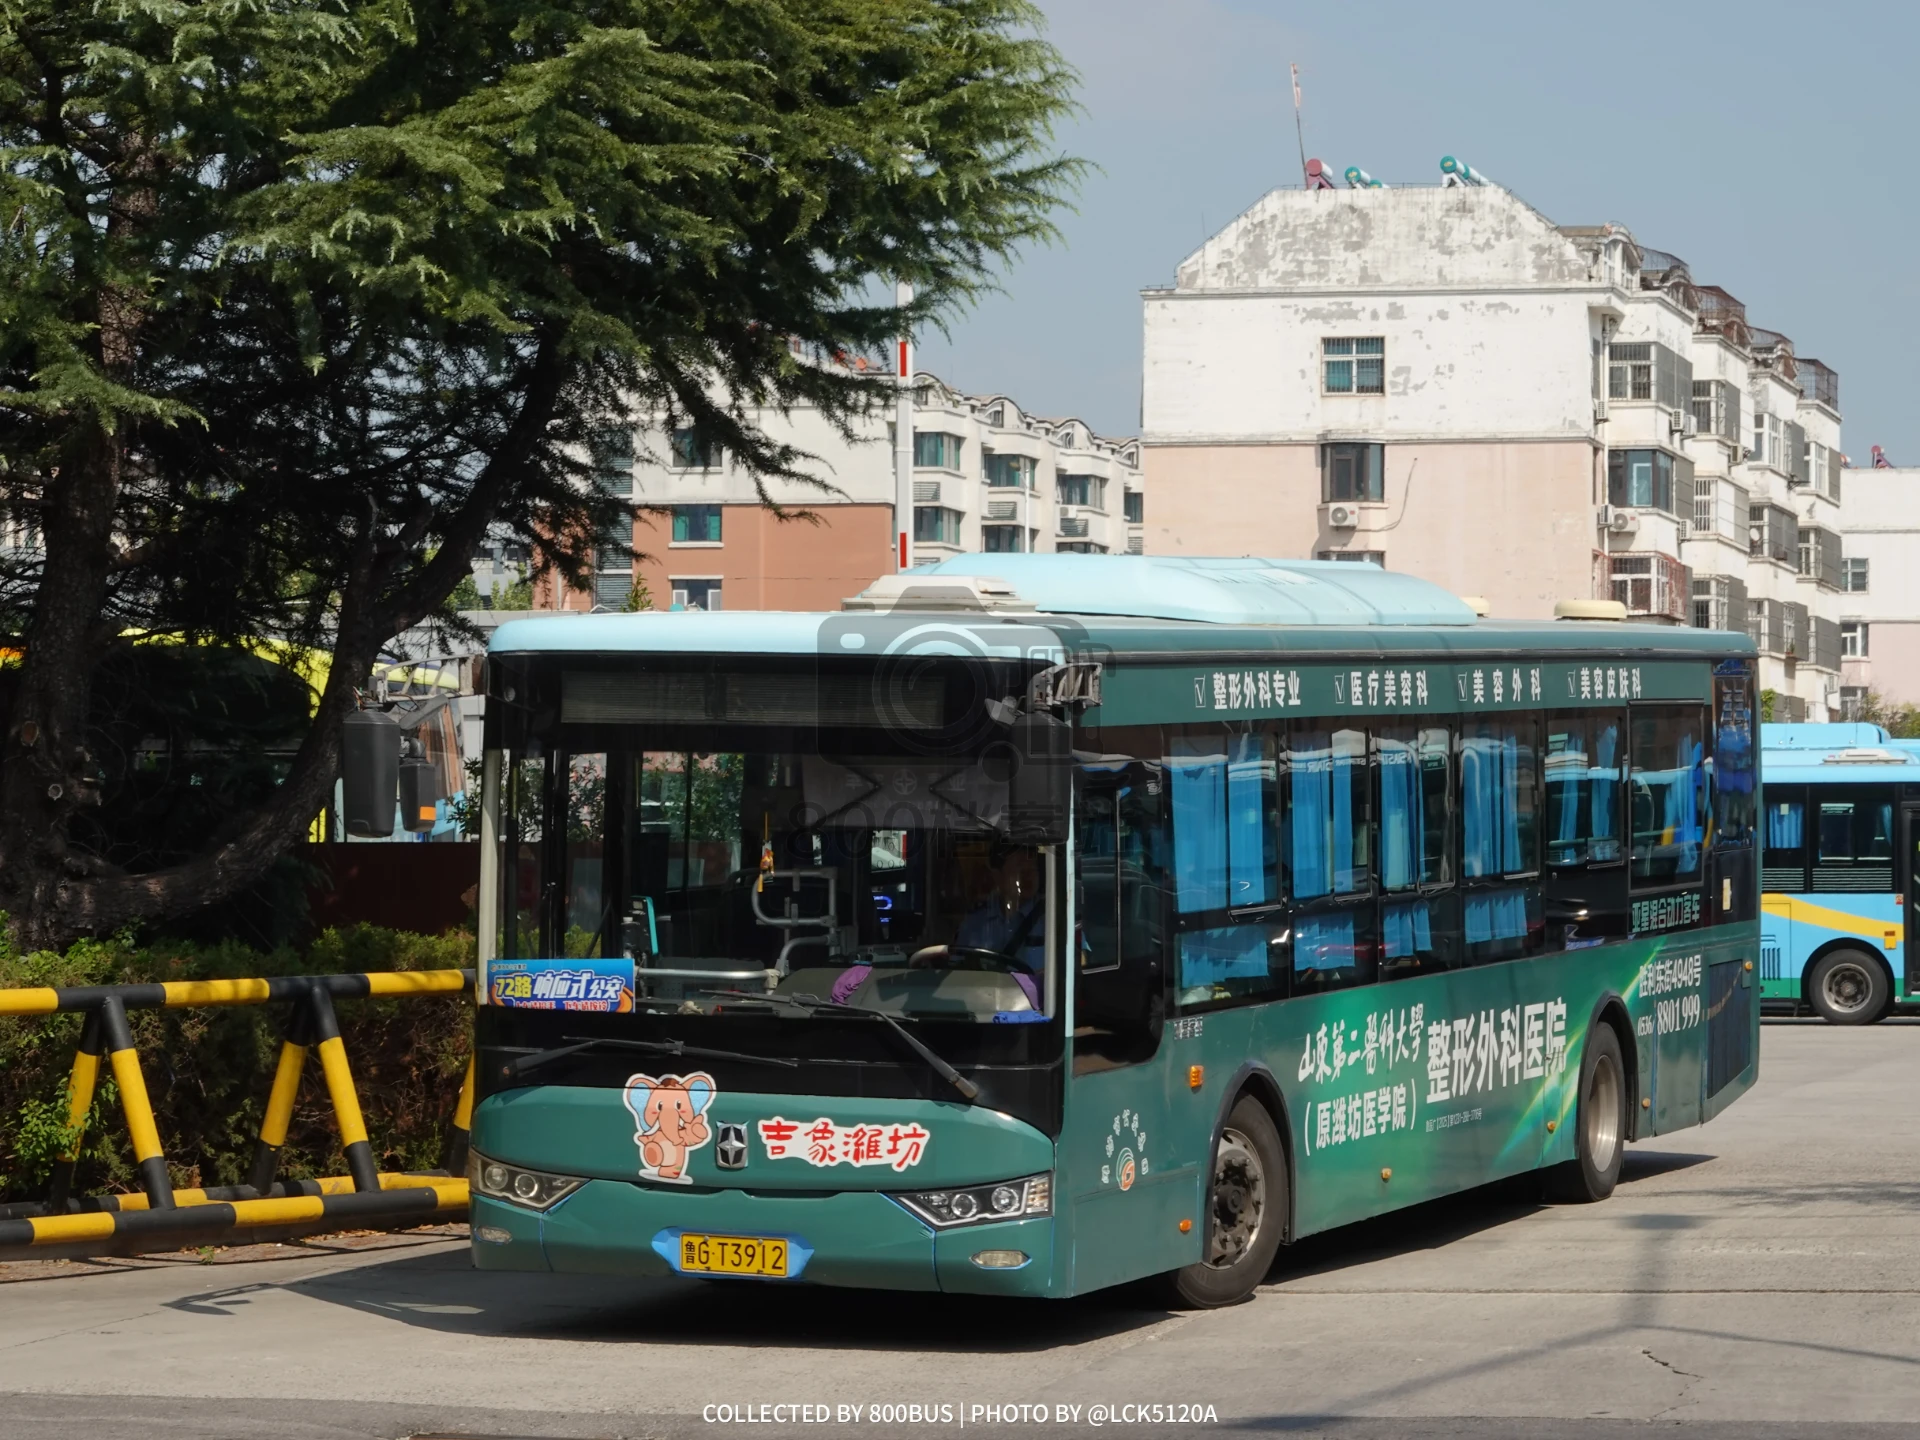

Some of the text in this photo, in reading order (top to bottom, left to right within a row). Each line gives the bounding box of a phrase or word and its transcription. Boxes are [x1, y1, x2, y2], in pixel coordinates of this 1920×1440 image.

[1212, 670, 1301, 710] 整形外科专业
[1350, 670, 1429, 706] 医疗美容科
[1472, 668, 1541, 704] 美容外科
[1580, 667, 1642, 700] 美容皮肤科
[1631, 893, 1701, 933] 亚星混合动力客车
[1638, 954, 1702, 999] 胜利东街4948号
[1426, 996, 1568, 1104] 整形外科医院
